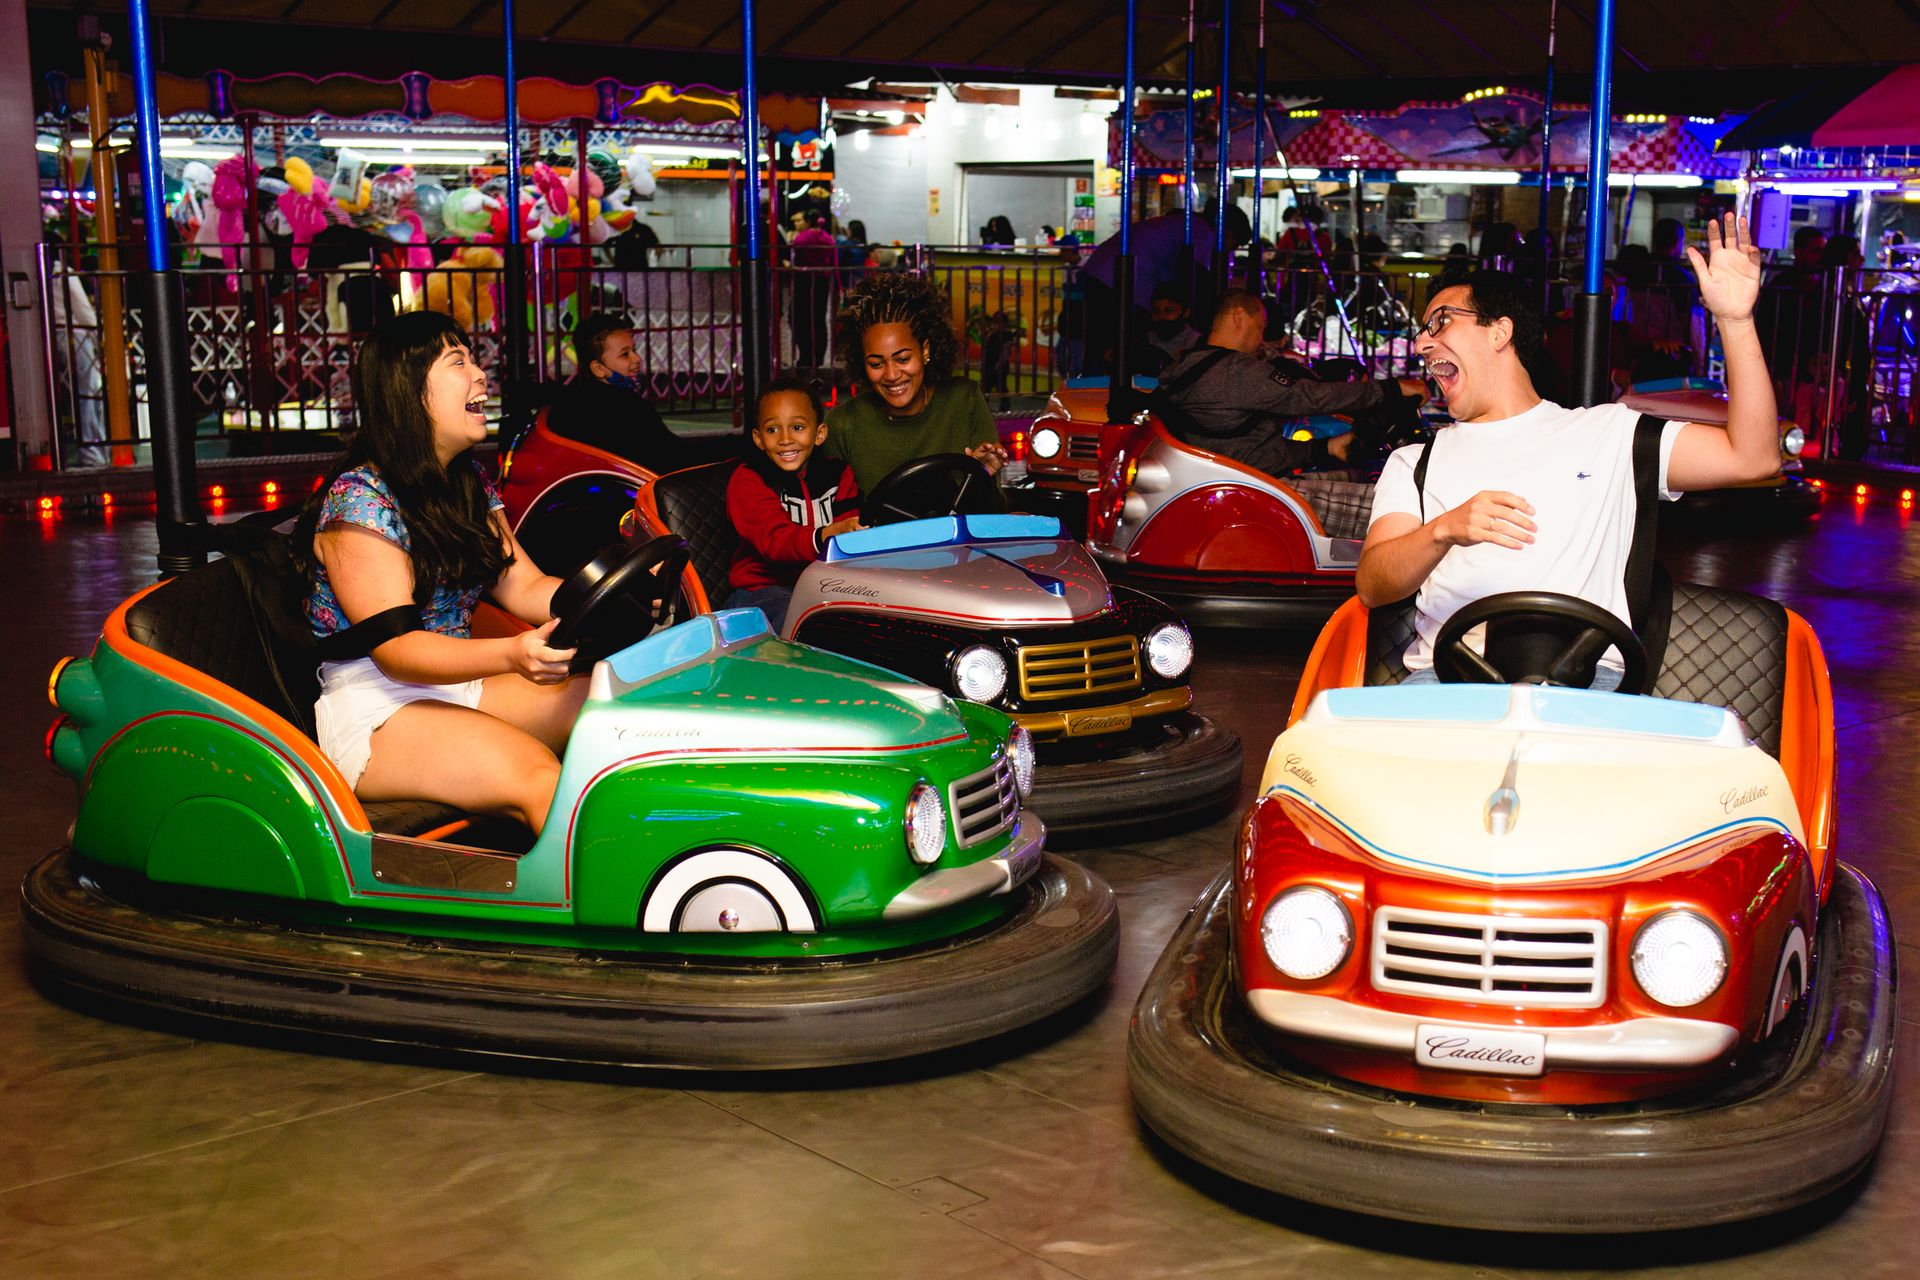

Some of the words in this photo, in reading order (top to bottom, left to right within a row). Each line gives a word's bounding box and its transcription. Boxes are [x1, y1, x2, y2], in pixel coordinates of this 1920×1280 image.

[820, 578, 880, 597] Cadillac
[1069, 715, 1129, 733] Cadillac
[1283, 753, 1317, 787] Cadillac
[1719, 785, 1768, 814] Cadillac
[1426, 1036, 1536, 1065] Cadillac
